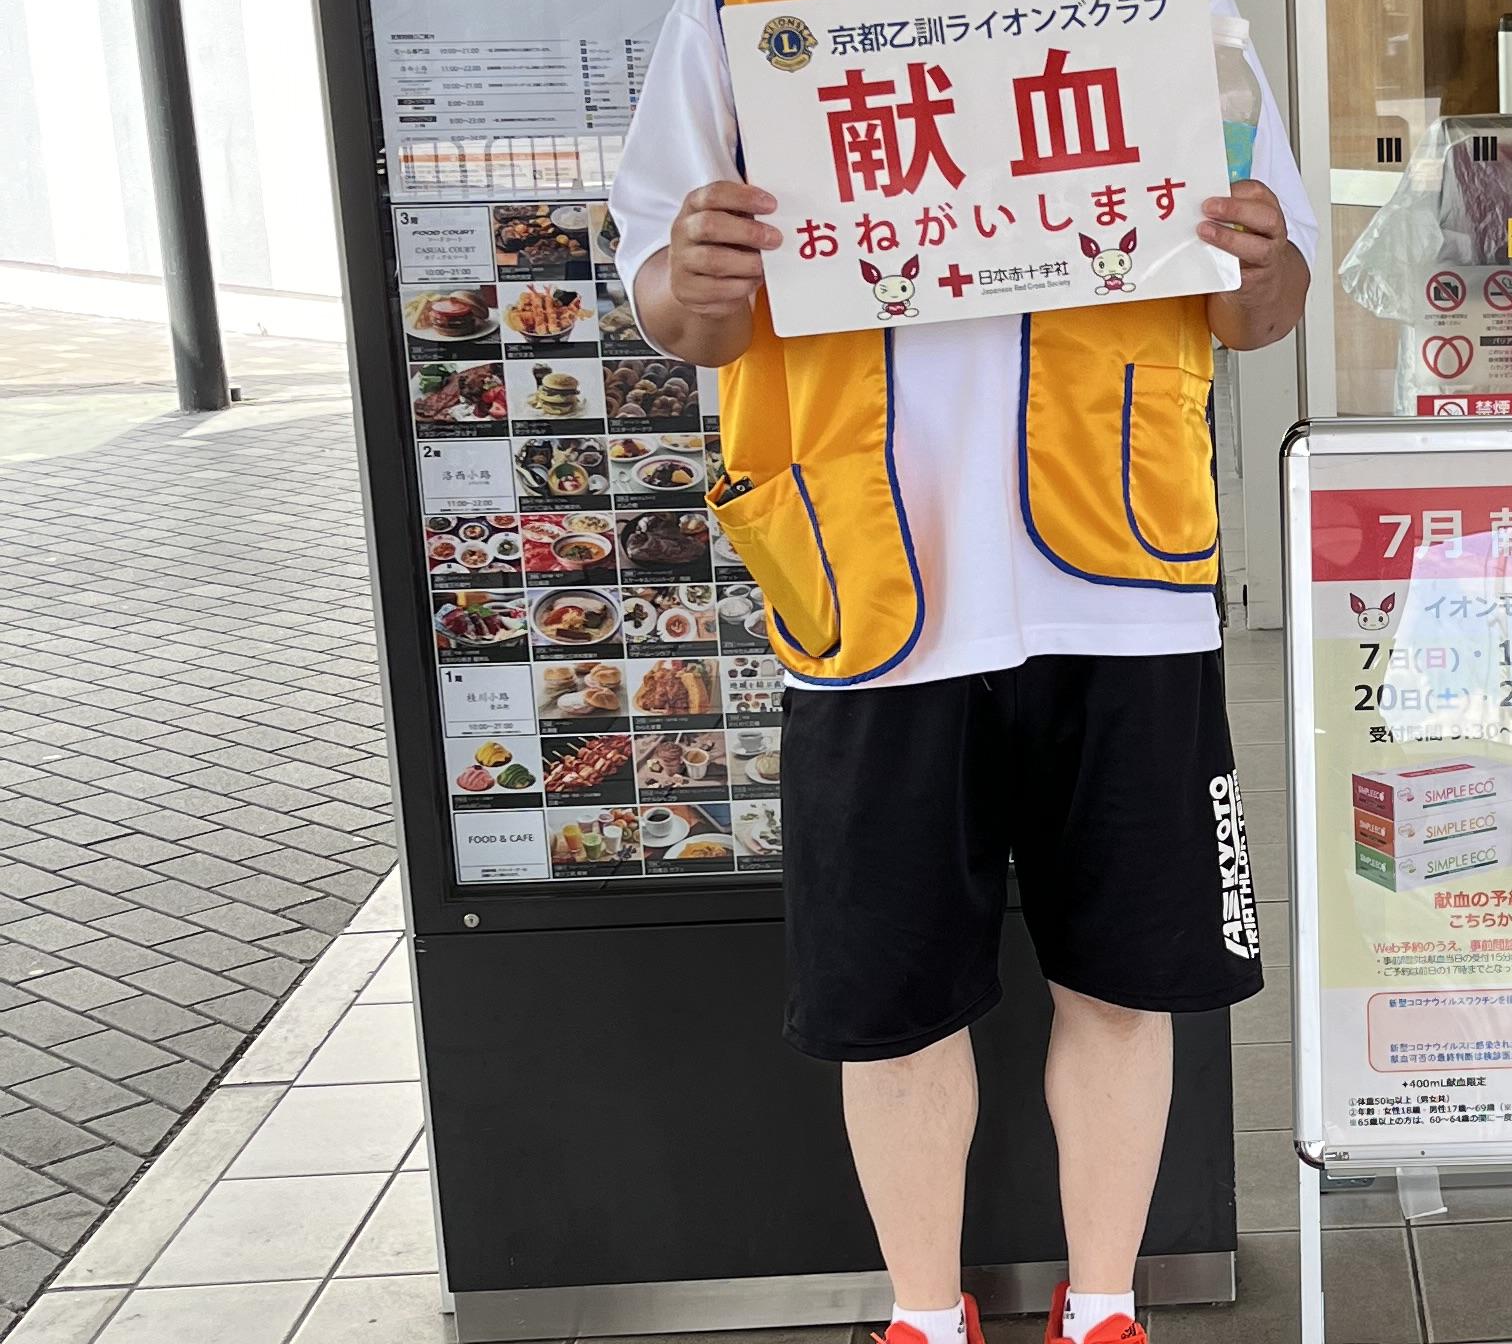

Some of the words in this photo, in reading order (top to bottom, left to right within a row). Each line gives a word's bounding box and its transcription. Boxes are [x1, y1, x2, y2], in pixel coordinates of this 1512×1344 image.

[781, 33, 798, 53] L
[817, 47, 1141, 203] 献血
[797, 176, 1188, 261] おねがいします
[978, 261, 1070, 285] 日本赤十字社
[1378, 510, 1462, 559] 7月
[1425, 785, 1466, 803] SIMPLE
[1468, 780, 1495, 796] ECO
[468, 833, 498, 844] FOOD
[509, 832, 535, 843] CAFE
[1425, 819, 1467, 839] SIMPLE
[1469, 814, 1496, 830] ECO
[1426, 854, 1468, 874] SIMPLE
[1470, 847, 1496, 864] ECO
